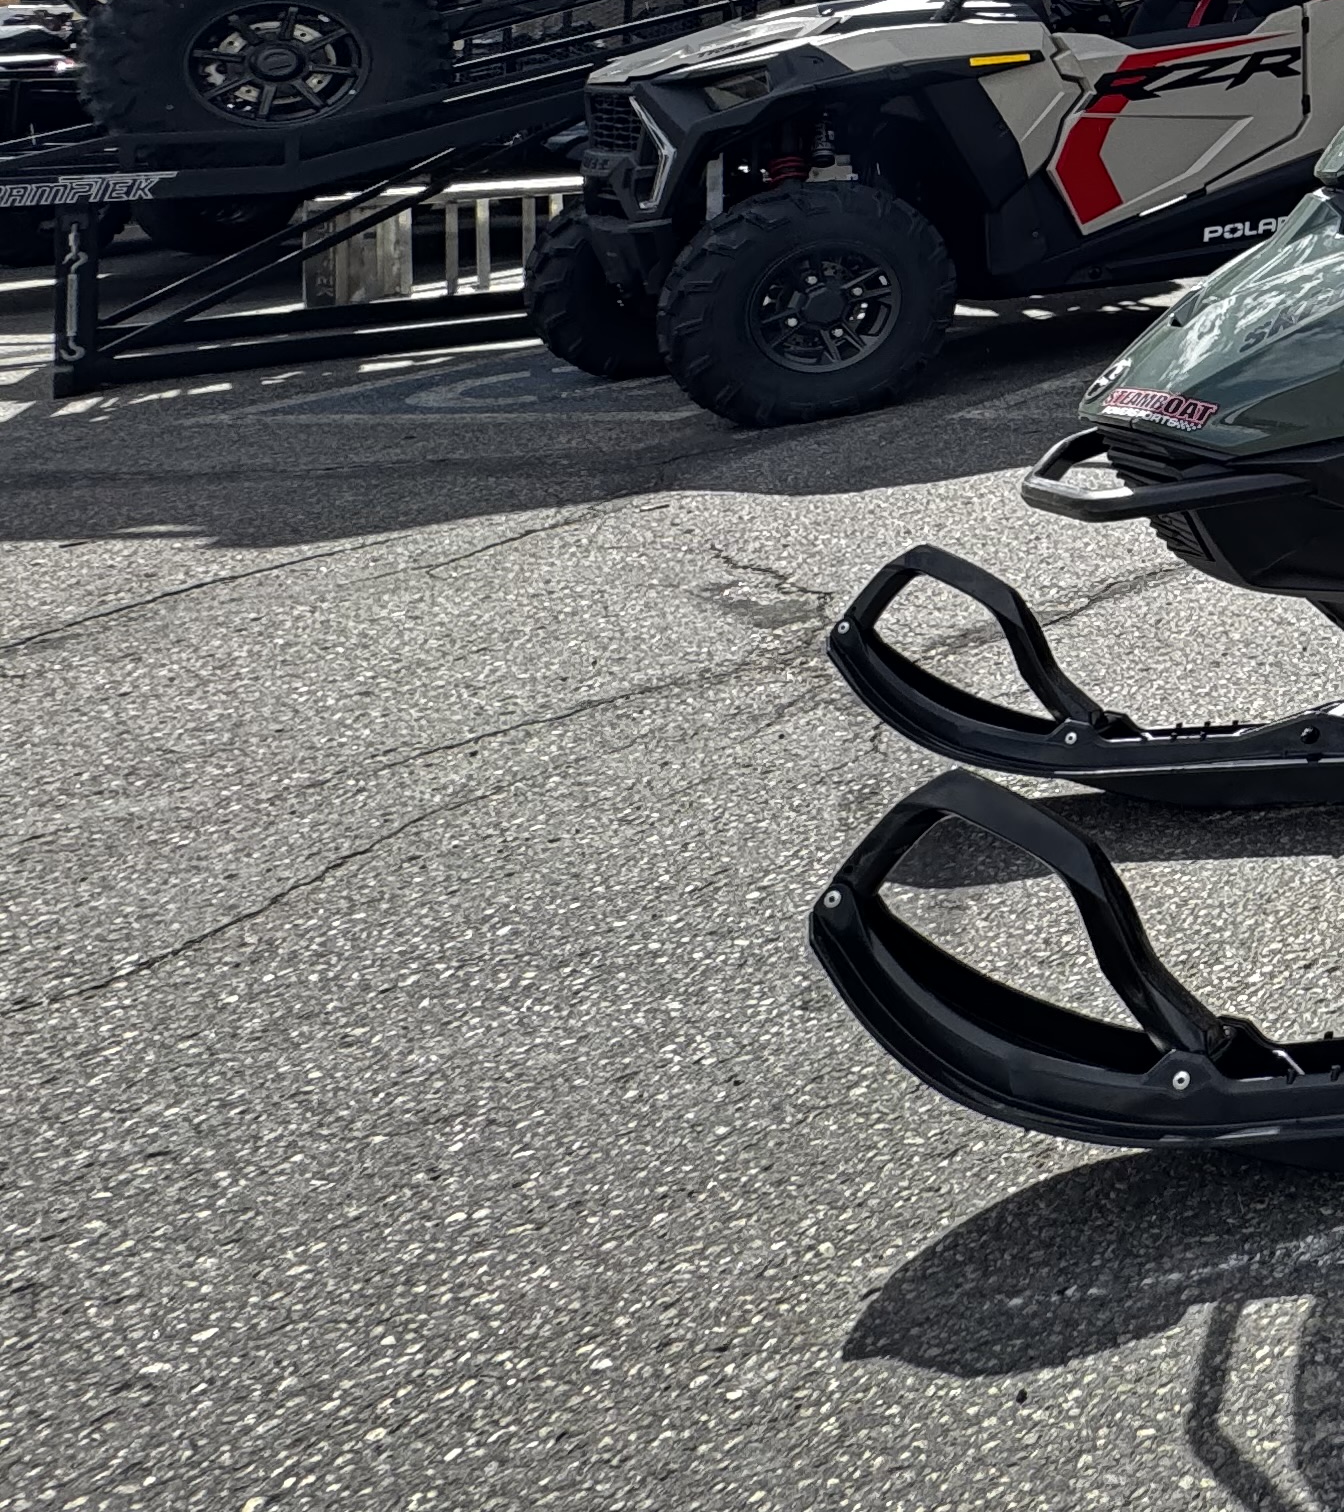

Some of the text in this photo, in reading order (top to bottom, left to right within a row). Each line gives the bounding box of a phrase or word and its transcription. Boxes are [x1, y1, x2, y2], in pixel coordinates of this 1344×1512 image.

[1087, 46, 1302, 106] RZR
[0, 171, 179, 207] AMPTEK
[1104, 388, 1218, 425] STEAMBOAT
